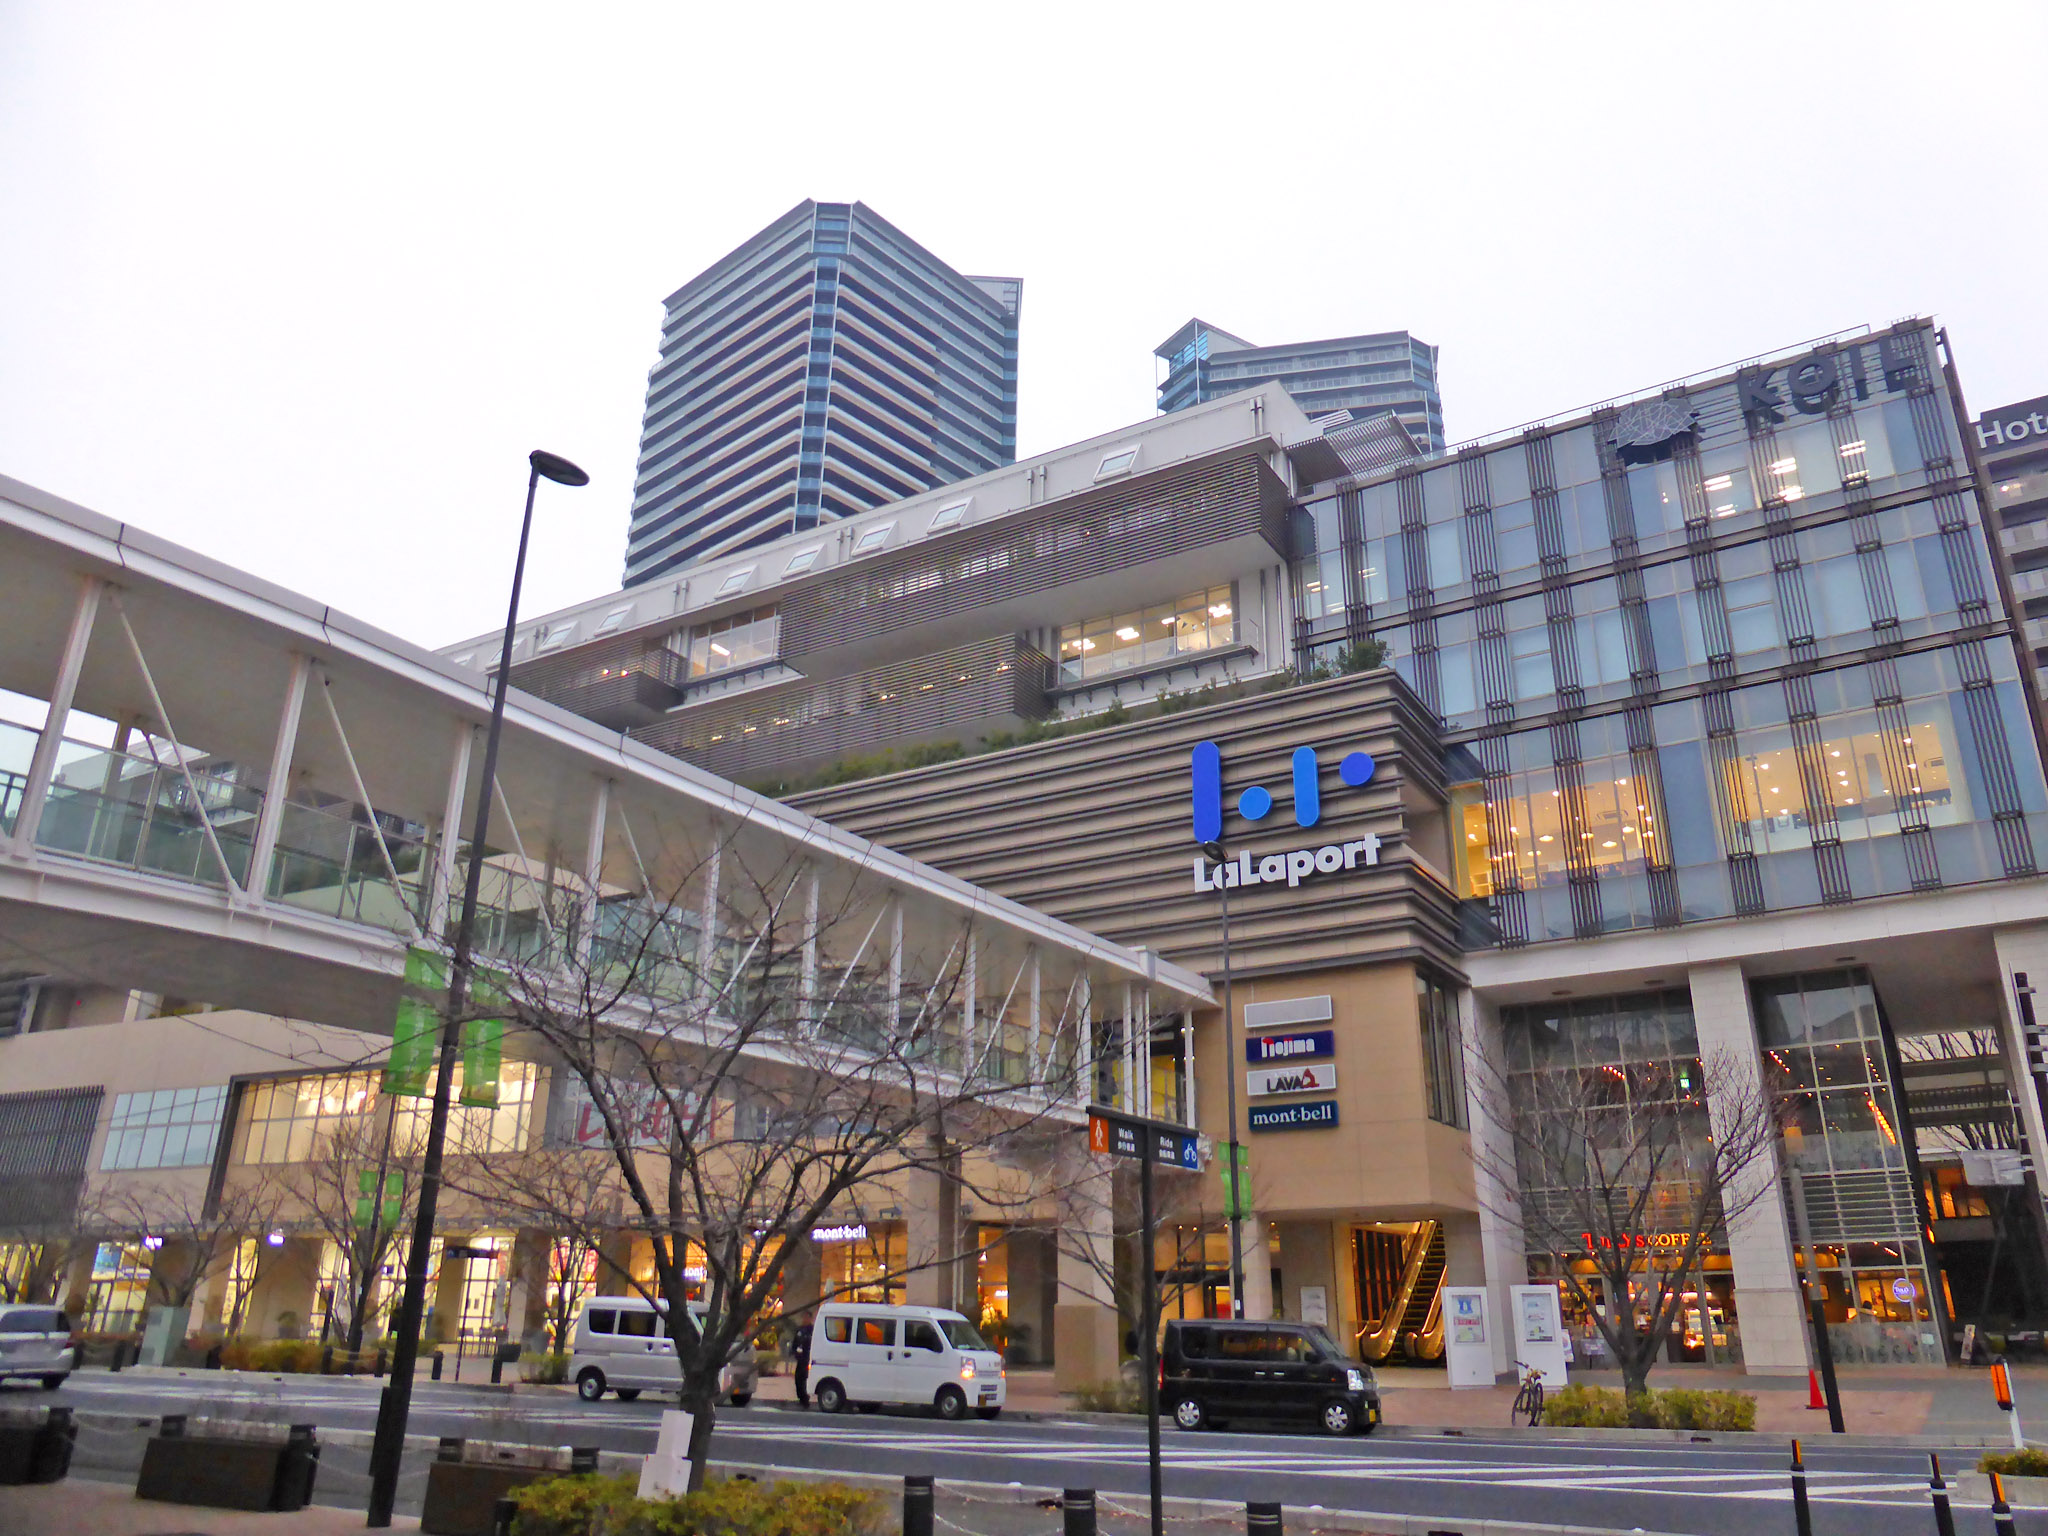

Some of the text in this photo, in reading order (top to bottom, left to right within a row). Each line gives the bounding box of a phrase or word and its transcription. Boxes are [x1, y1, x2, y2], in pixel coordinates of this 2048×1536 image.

[1737, 336, 1915, 416] KOIL
[1976, 412, 2048, 448] Hot
[1193, 832, 1381, 892] LaLaport
[1261, 1036, 1315, 1058] nojima
[1266, 1075, 1304, 1092] LAVA
[1118, 1127, 1134, 1140] Walk
